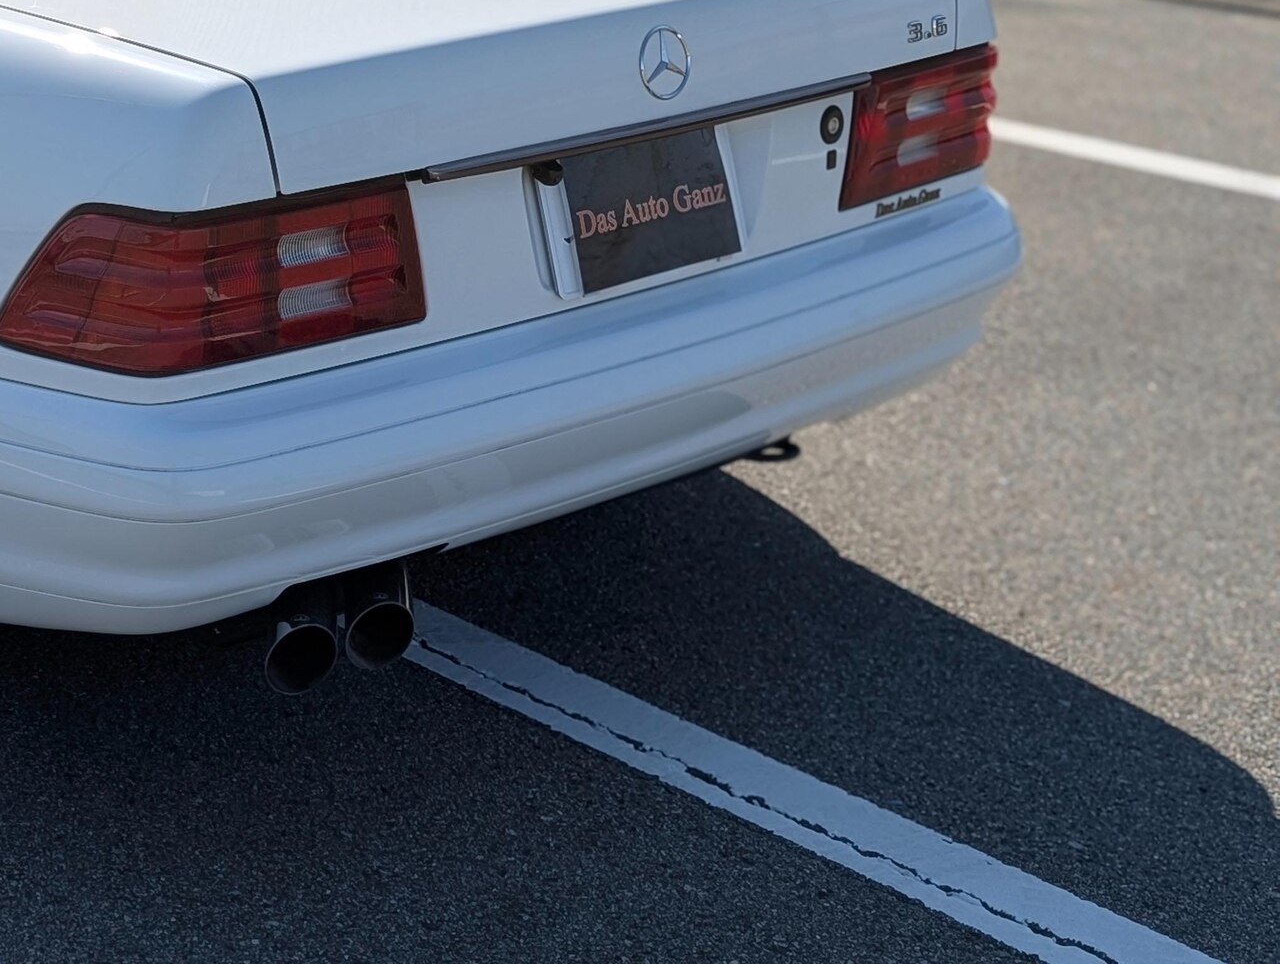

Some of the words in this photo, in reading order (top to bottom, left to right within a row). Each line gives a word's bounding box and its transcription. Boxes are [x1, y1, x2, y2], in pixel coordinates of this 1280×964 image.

[907, 15, 948, 43] 3.6
[576, 209, 618, 239] Das
[621, 196, 669, 227] Auto
[672, 183, 727, 213] Ganz
